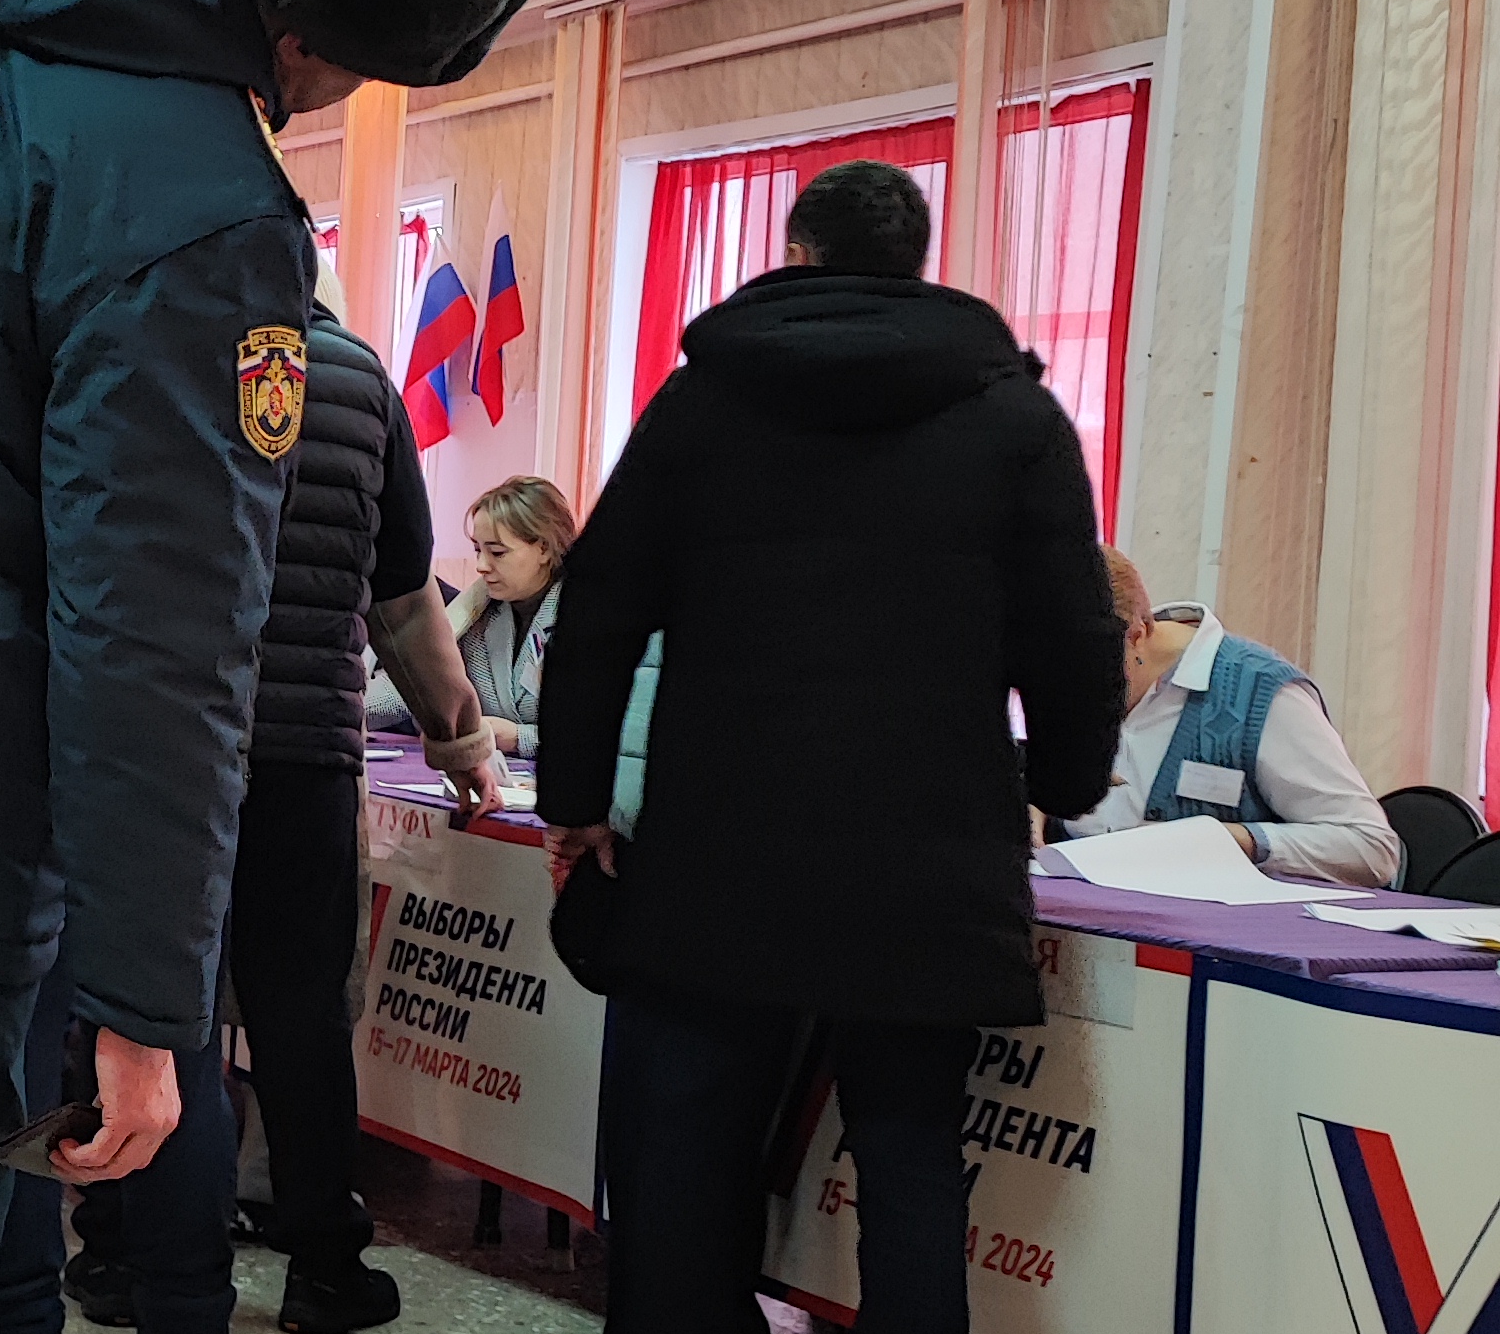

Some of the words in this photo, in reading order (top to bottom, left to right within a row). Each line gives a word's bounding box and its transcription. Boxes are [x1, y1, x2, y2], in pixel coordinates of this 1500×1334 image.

[398, 892, 514, 952] ВЫБОРЫ
[386, 938, 547, 1015] ПРЕЗИДЕНТА
[375, 983, 471, 1043] РОССИИ
[411, 1042, 470, 1088] МАРТА
[472, 1063, 522, 1104] 2024
[981, 1232, 1056, 1288] 2024
